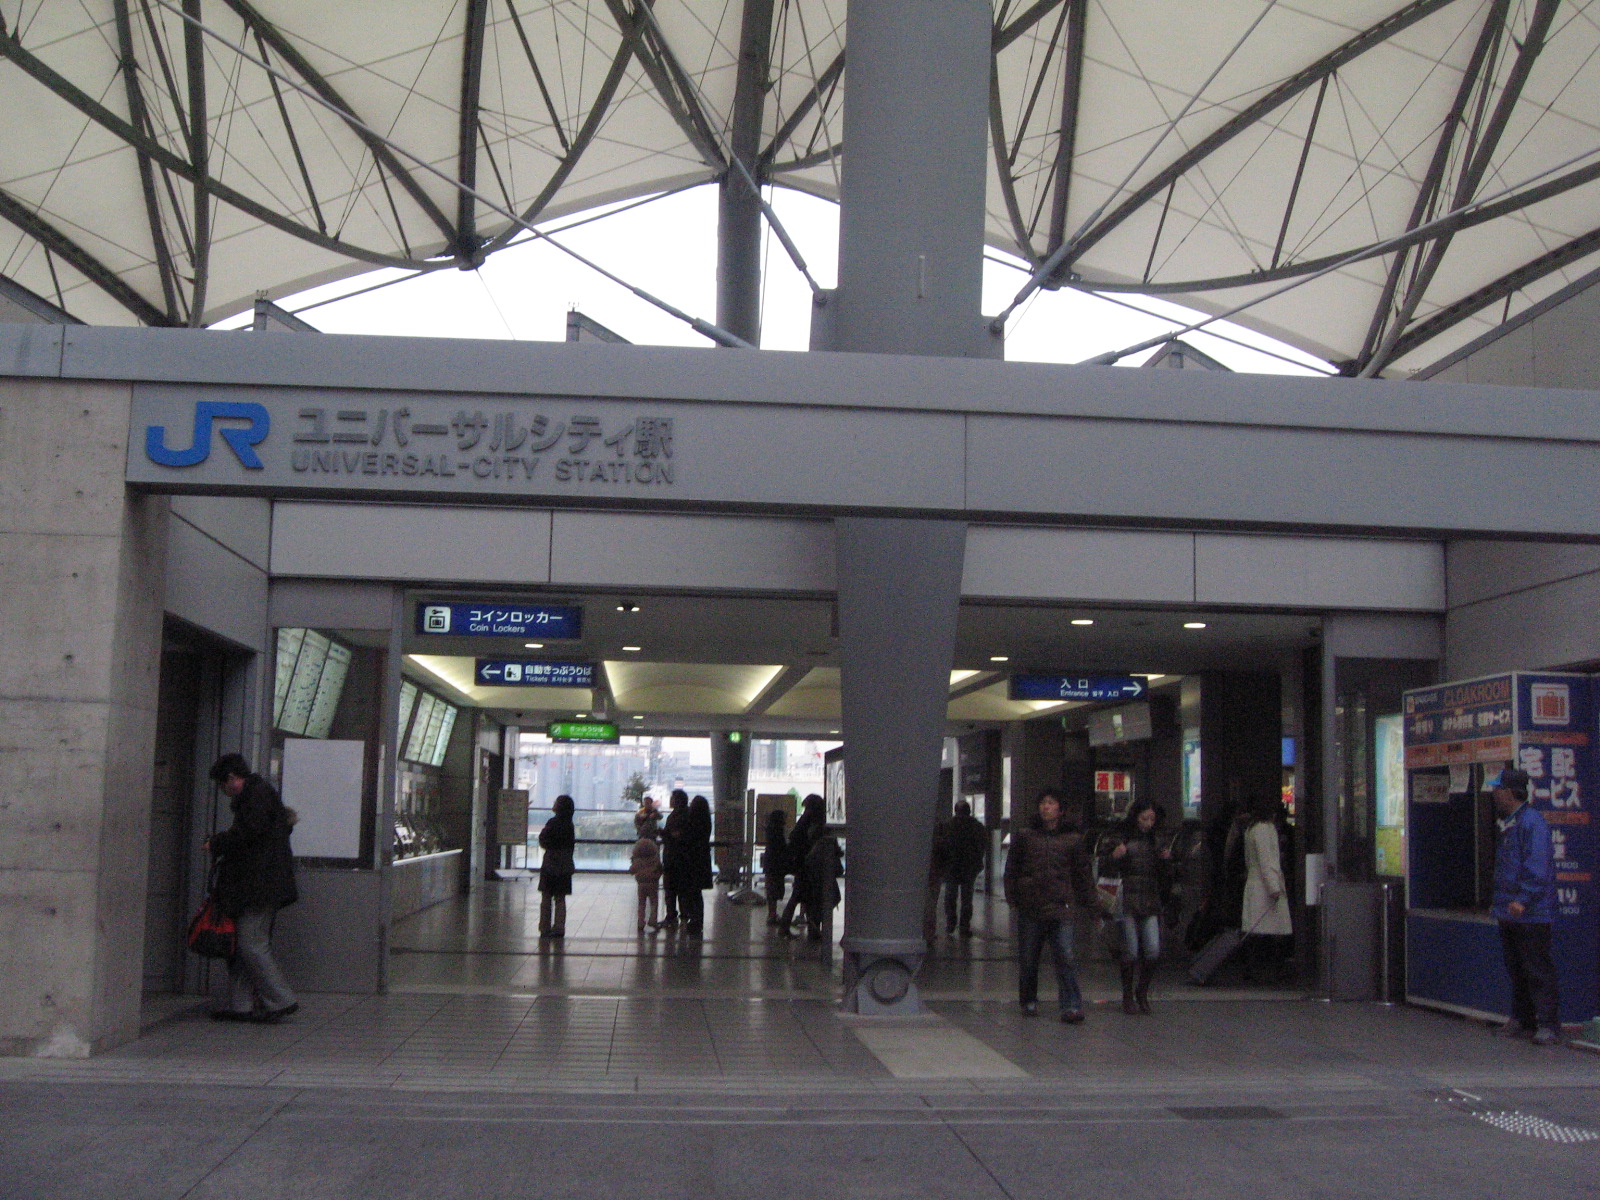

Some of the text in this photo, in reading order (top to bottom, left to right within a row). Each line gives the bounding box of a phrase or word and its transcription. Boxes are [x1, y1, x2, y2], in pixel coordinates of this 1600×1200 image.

[146, 401, 270, 469] JR
[293, 407, 674, 459] ユニバーサルシティ駅
[292, 448, 674, 484] UNIVERSAL-CITY STATION
[469, 610, 563, 624] コインロッカー
[469, 623, 526, 633] Coin Lockers
[524, 664, 593, 676] 自動きっぷうりば
[1060, 678, 1089, 689] 入口
[1060, 689, 1090, 697] Entrance
